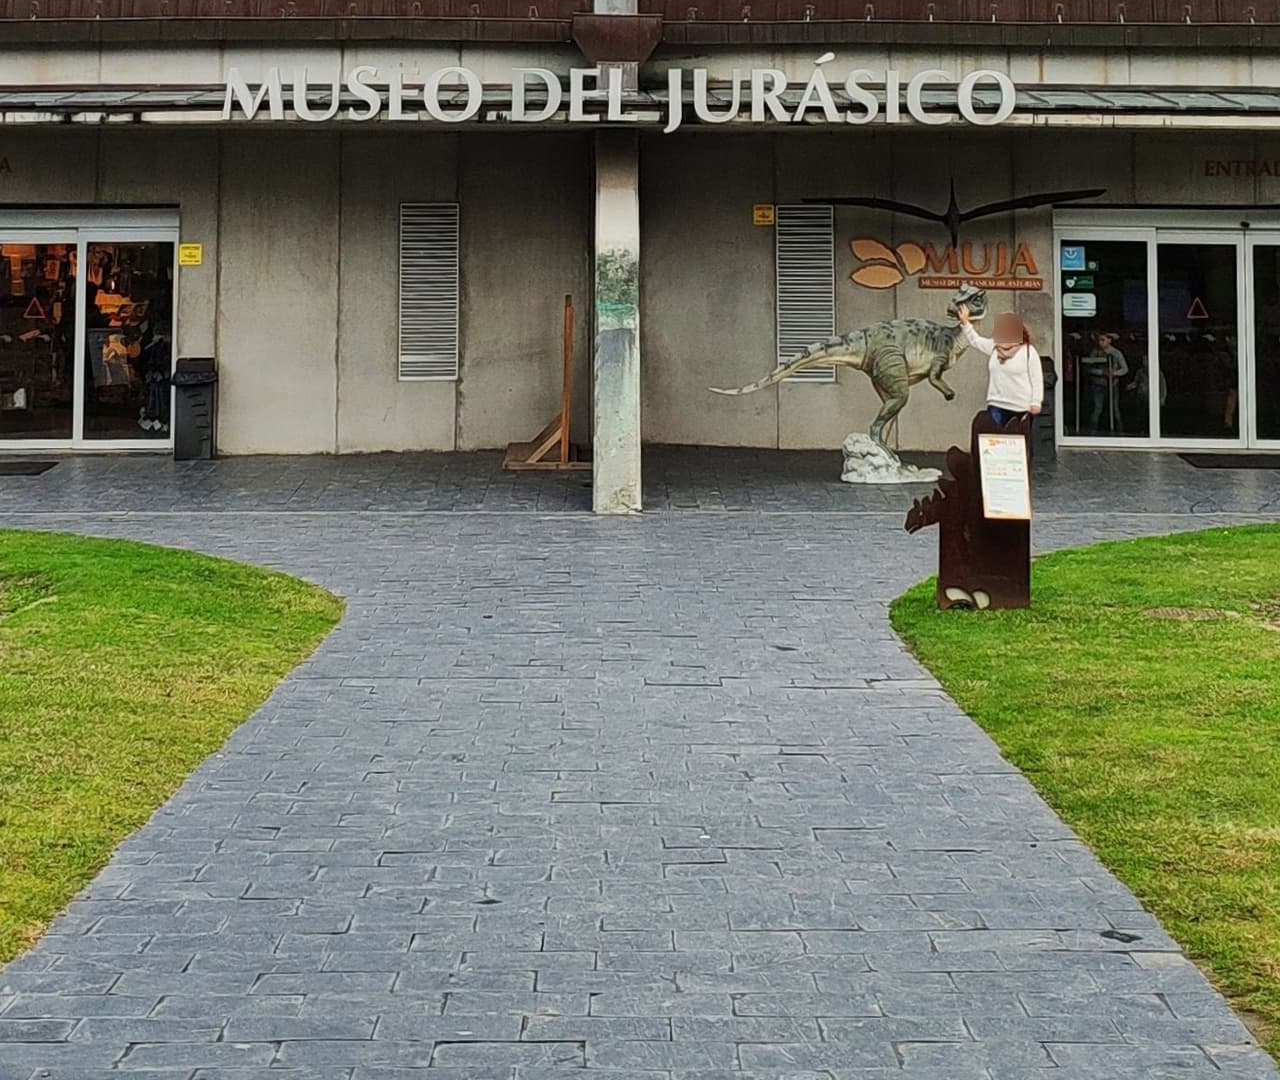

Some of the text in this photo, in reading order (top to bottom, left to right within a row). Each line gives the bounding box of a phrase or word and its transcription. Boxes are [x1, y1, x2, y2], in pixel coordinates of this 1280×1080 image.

[222, 52, 1017, 134] MUSEO DEL JURÁSICO
[920, 241, 1039, 277] MUJA
